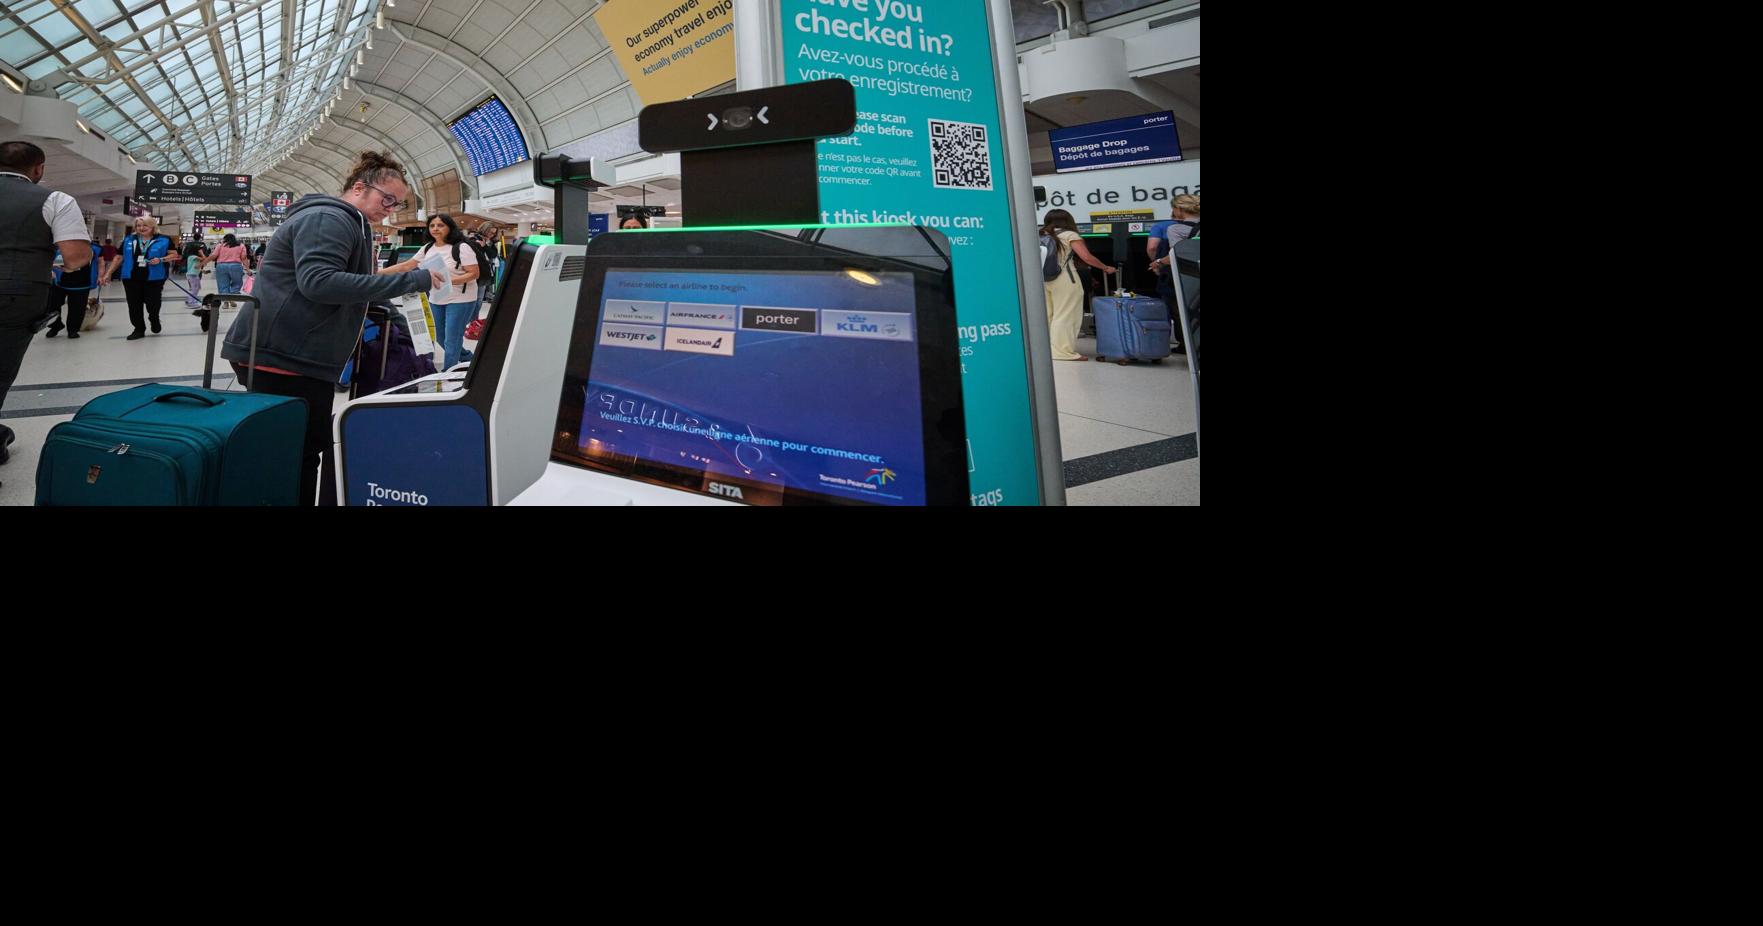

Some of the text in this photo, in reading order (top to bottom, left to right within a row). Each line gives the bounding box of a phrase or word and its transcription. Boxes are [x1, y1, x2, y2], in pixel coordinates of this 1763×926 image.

[876, 0, 922, 23] you
[635, 0, 733, 62] economy travel enjo
[795, 8, 953, 56] checked in?
[626, 33, 642, 48] Our
[642, 22, 734, 76] Actually enjoy econom
[798, 43, 960, 81] Avez-vous procédé à
[850, 74, 972, 103] enregistrement?
[881, 113, 906, 124] scan
[1143, 115, 1168, 125] porter
[854, 122, 913, 138] ode before
[1058, 138, 1128, 154] Baggage Drop
[1060, 151, 1088, 161] Dépôt
[1105, 144, 1150, 157] bagages
[846, 155, 861, 164] pas
[863, 155, 870, 163] le
[889, 158, 917, 167] veuillez
[841, 165, 863, 174] votre
[886, 167, 899, 176] QR
[900, 169, 921, 177] avant
[818, 176, 872, 185] commencer.
[1086, 188, 1120, 205] de
[833, 209, 868, 225] this
[872, 210, 917, 226] kiosk
[953, 216, 984, 228] can:
[756, 314, 800, 326] porter
[837, 322, 878, 333] KLM
[606, 331, 646, 341] WESTJET
[980, 323, 1012, 342] pass
[677, 338, 712, 346] ICELANDAIR
[600, 411, 632, 424] Veuillez
[633, 416, 656, 428] S.V.P.
[735, 431, 779, 448] aérienne
[782, 440, 808, 451] pour
[810, 444, 885, 464] commencer.
[819, 473, 877, 490] Toronto Pearson
[367, 482, 428, 506] Toronto
[709, 482, 743, 499] SITA
[970, 488, 1003, 506] tags
